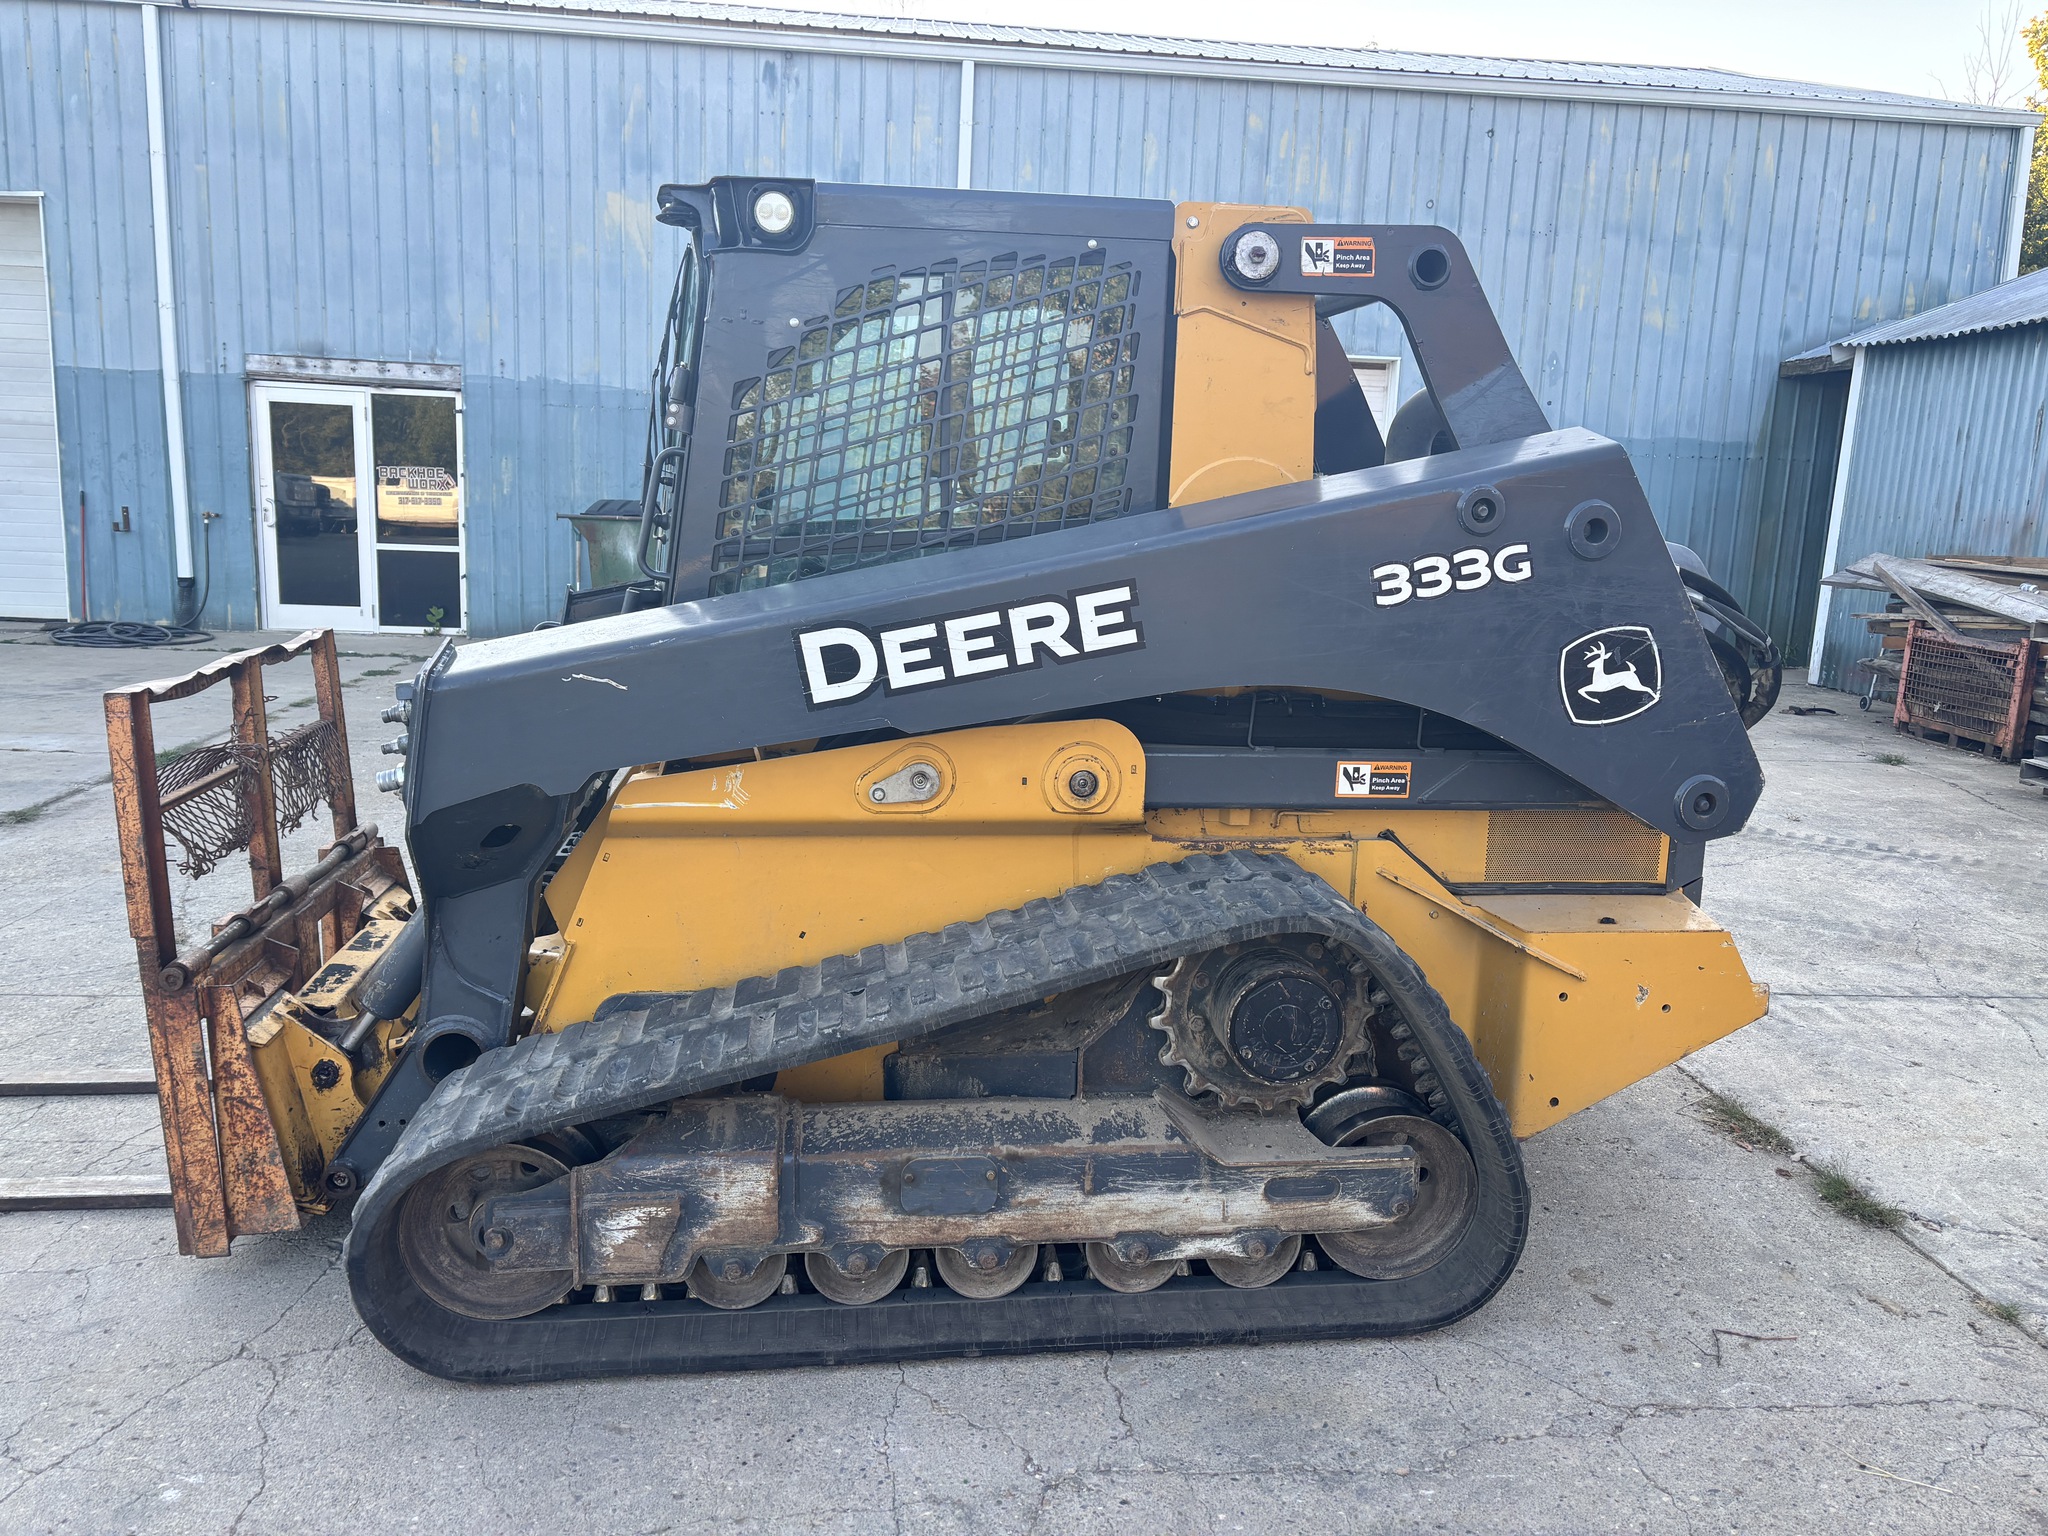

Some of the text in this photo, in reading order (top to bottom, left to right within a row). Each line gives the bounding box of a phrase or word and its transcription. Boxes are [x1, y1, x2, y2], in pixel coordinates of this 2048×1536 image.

[378, 466, 445, 479] BACKHOE
[408, 478, 449, 491] WORX
[1372, 544, 1532, 606] 333G
[799, 586, 1138, 704] DEERE
